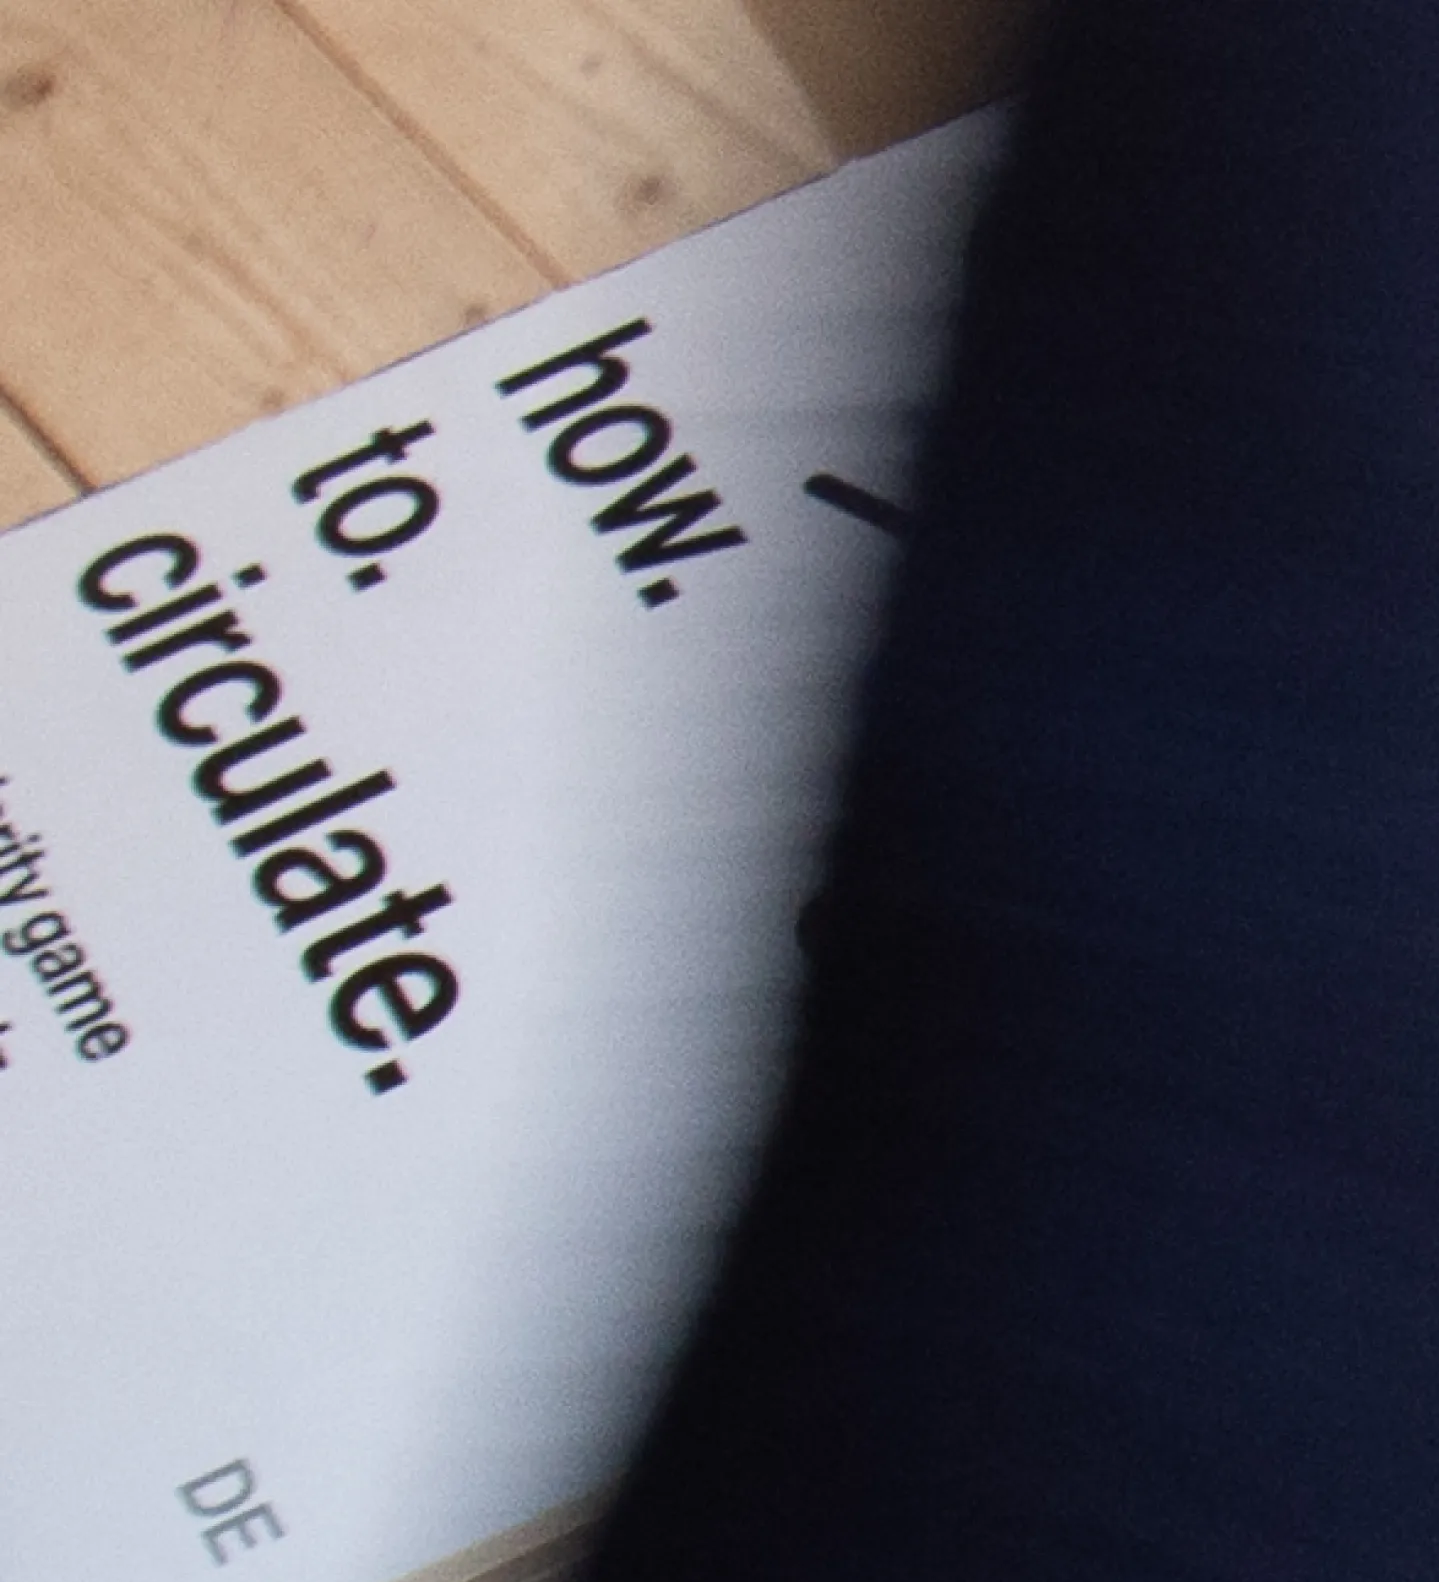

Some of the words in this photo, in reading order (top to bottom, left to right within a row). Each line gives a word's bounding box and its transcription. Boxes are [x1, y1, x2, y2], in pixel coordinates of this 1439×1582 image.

[290, 419, 441, 593] to.
[494, 316, 749, 610] how.
[75, 531, 462, 1097] circulate.
[1, 910, 131, 1063] game
[176, 1457, 287, 1568] DE
